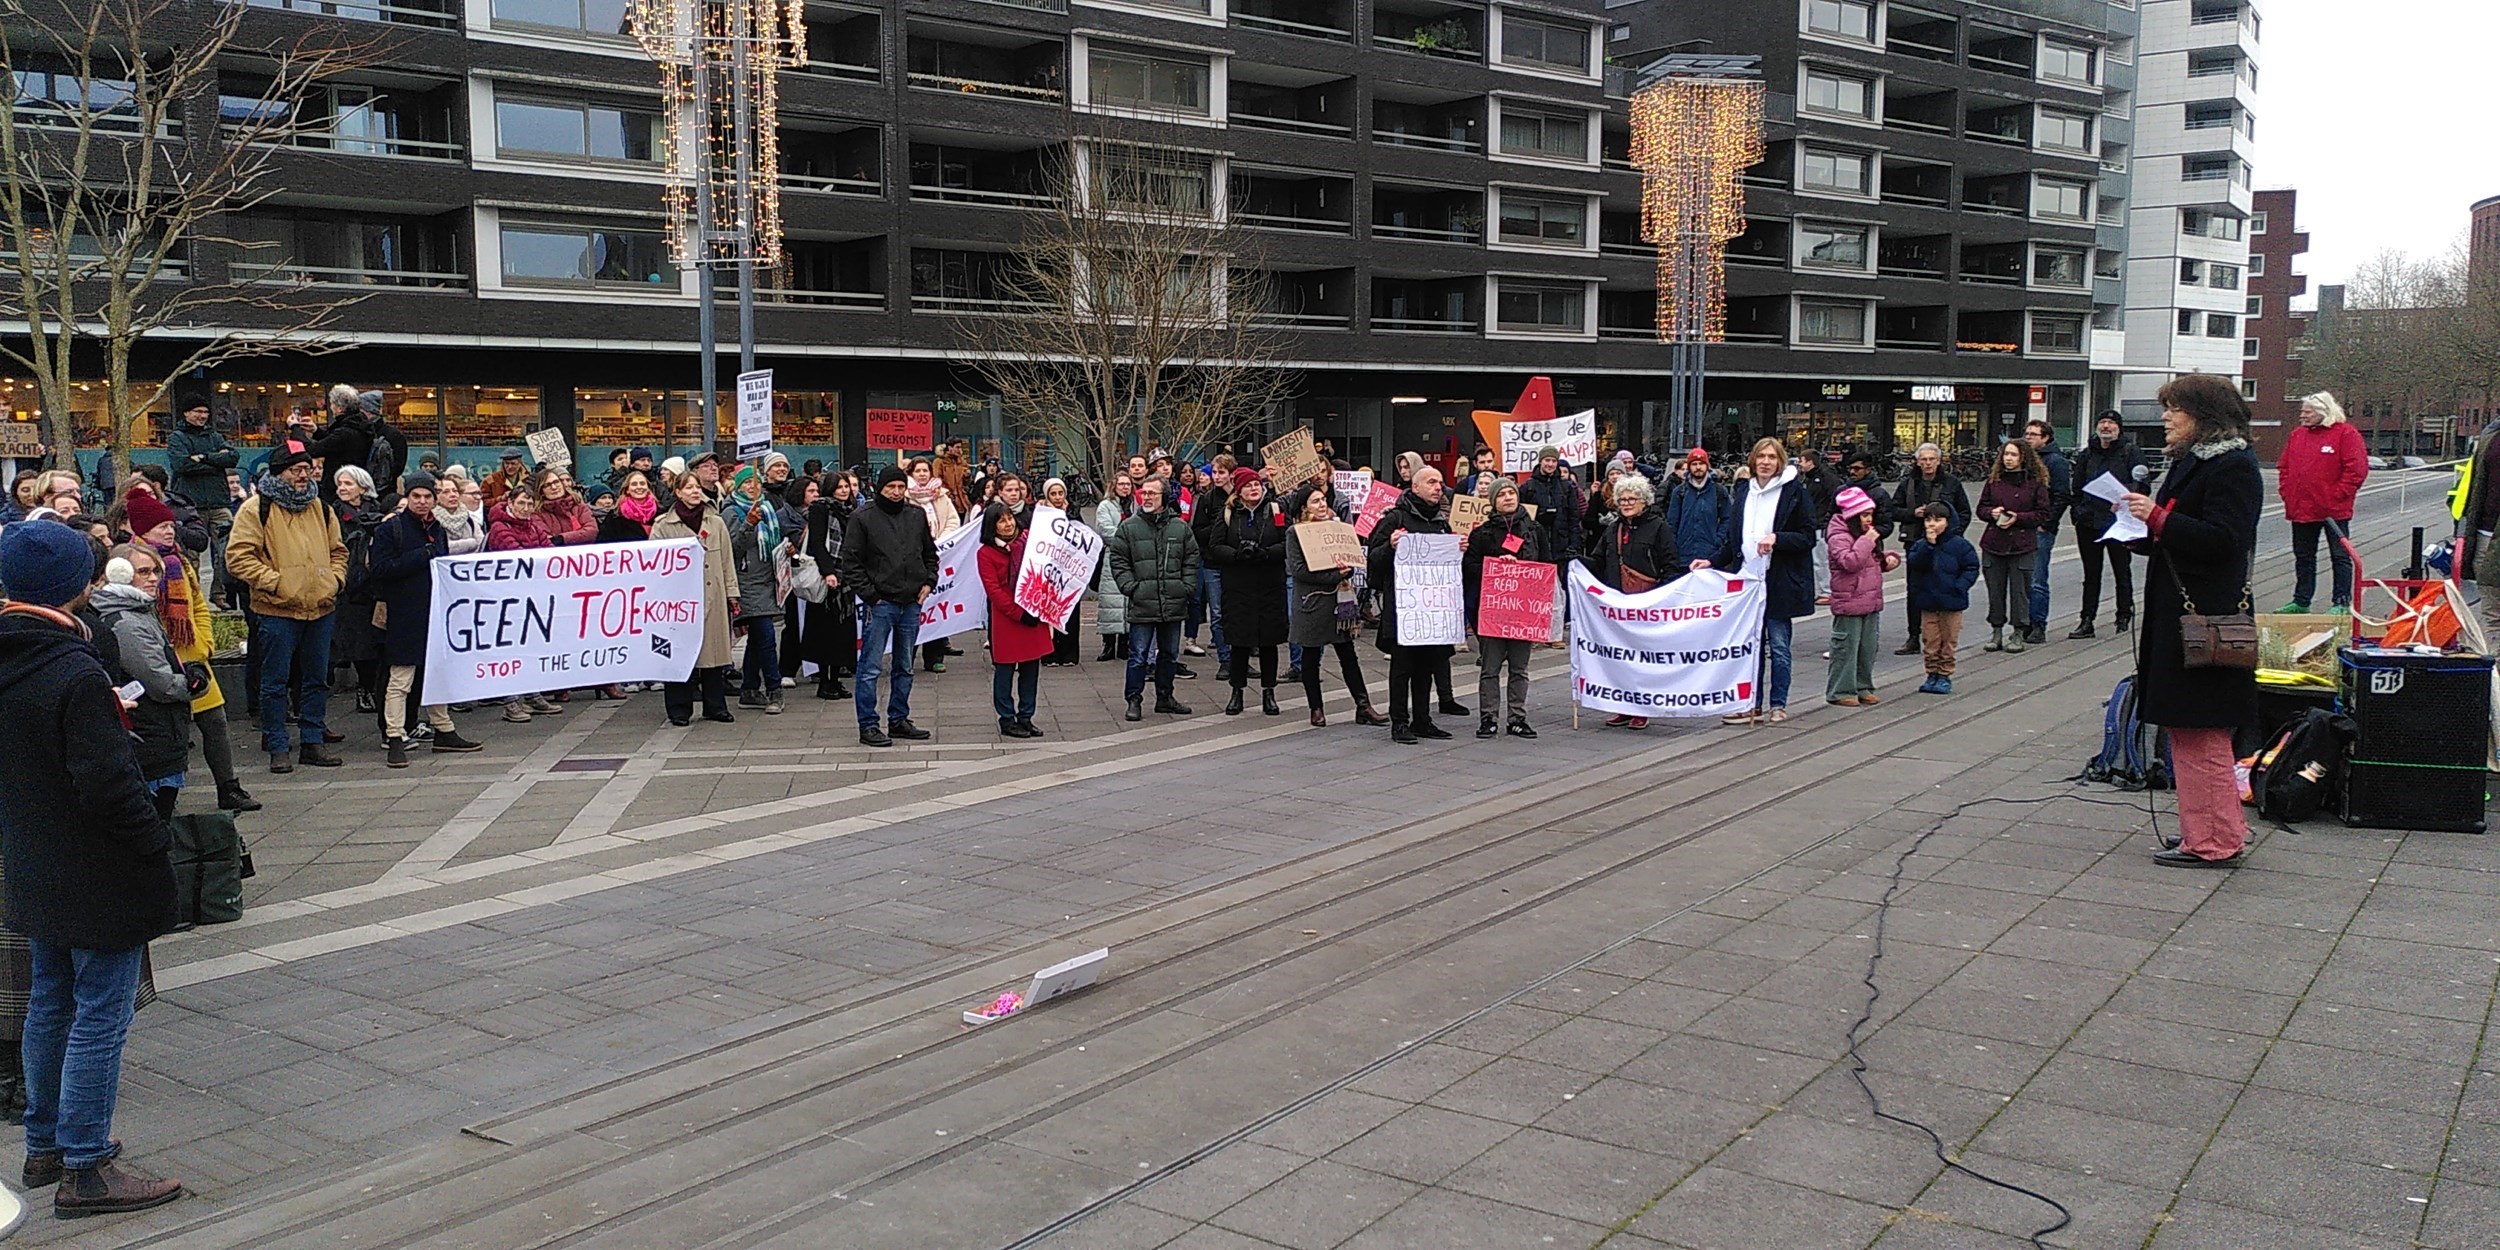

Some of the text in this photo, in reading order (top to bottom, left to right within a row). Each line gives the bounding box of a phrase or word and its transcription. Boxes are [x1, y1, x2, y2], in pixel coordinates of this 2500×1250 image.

[1925, 386, 1955, 401] KAMERA
[869, 412, 929, 424] ONDERWIJS
[873, 433, 926, 446] TOEKOMST
[1511, 418, 1586, 444] Stop de
[0, 443, 38, 455] RACHT
[1262, 428, 1308, 459] UNIVERSITY
[1335, 482, 1359, 490] SLOPEN
[1336, 472, 1351, 481] STOP
[1459, 500, 1491, 515] ENG
[1454, 520, 1470, 529] THE
[1051, 518, 1094, 554] GEEN
[1397, 534, 1430, 561] ONS
[450, 548, 692, 581] GEEN ONDERWIJS
[1401, 560, 1462, 587] ONDERWIJS
[1489, 562, 1544, 580] IF YOU CAN
[1043, 563, 1070, 592] GEEN
[1494, 577, 1518, 591] READ
[1396, 587, 1457, 609] IS GEEN
[1486, 594, 1524, 611] THANK
[446, 586, 699, 652] GEEN TOEKOMST
[1600, 604, 1722, 622] TALENSTUDIES
[1577, 637, 1753, 664] KUNNEN NIET WORDEN
[476, 646, 628, 678] STOP THE CUTS
[1586, 682, 1735, 706] WEGGESCHOOFEN
